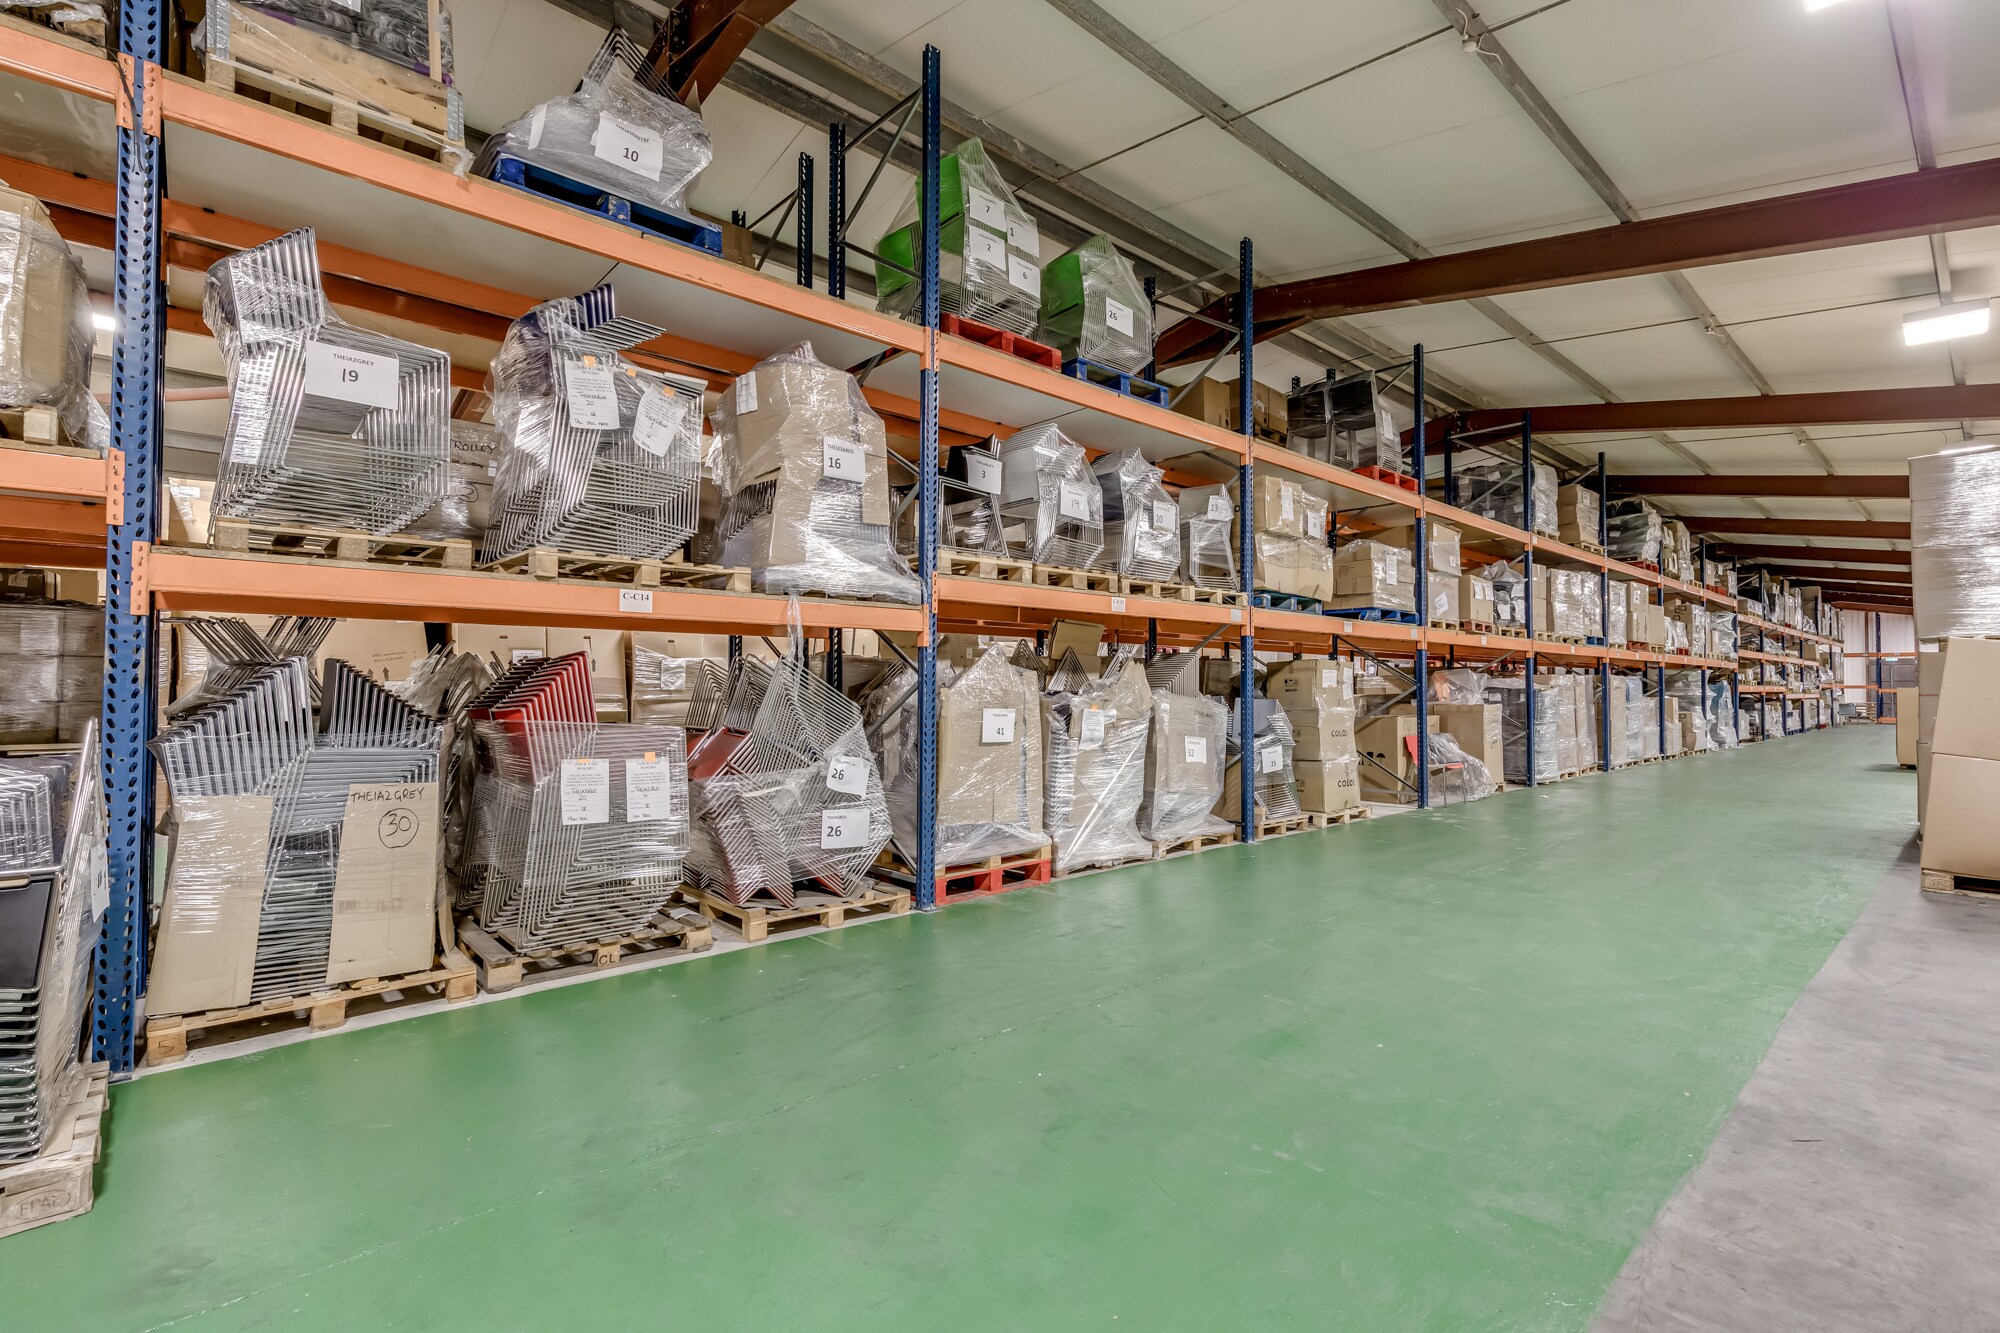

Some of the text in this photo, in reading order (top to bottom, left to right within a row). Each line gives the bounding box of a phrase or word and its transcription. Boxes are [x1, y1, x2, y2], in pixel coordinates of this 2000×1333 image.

[623, 147, 639, 162] 10
[985, 205, 990, 213] 7
[1010, 227, 1014, 237] 1
[987, 243, 991, 252] 2
[1109, 310, 1118, 320] 26
[333, 353, 374, 366] THEIA2GREY
[342, 368, 359, 382] 19
[828, 457, 841, 469] 16
[981, 470, 986, 478] 3
[623, 592, 650, 602] C-C14
[996, 727, 1005, 736] 41
[831, 768, 844, 780] 26
[386, 813, 412, 837] 30
[827, 826, 842, 837] 26
